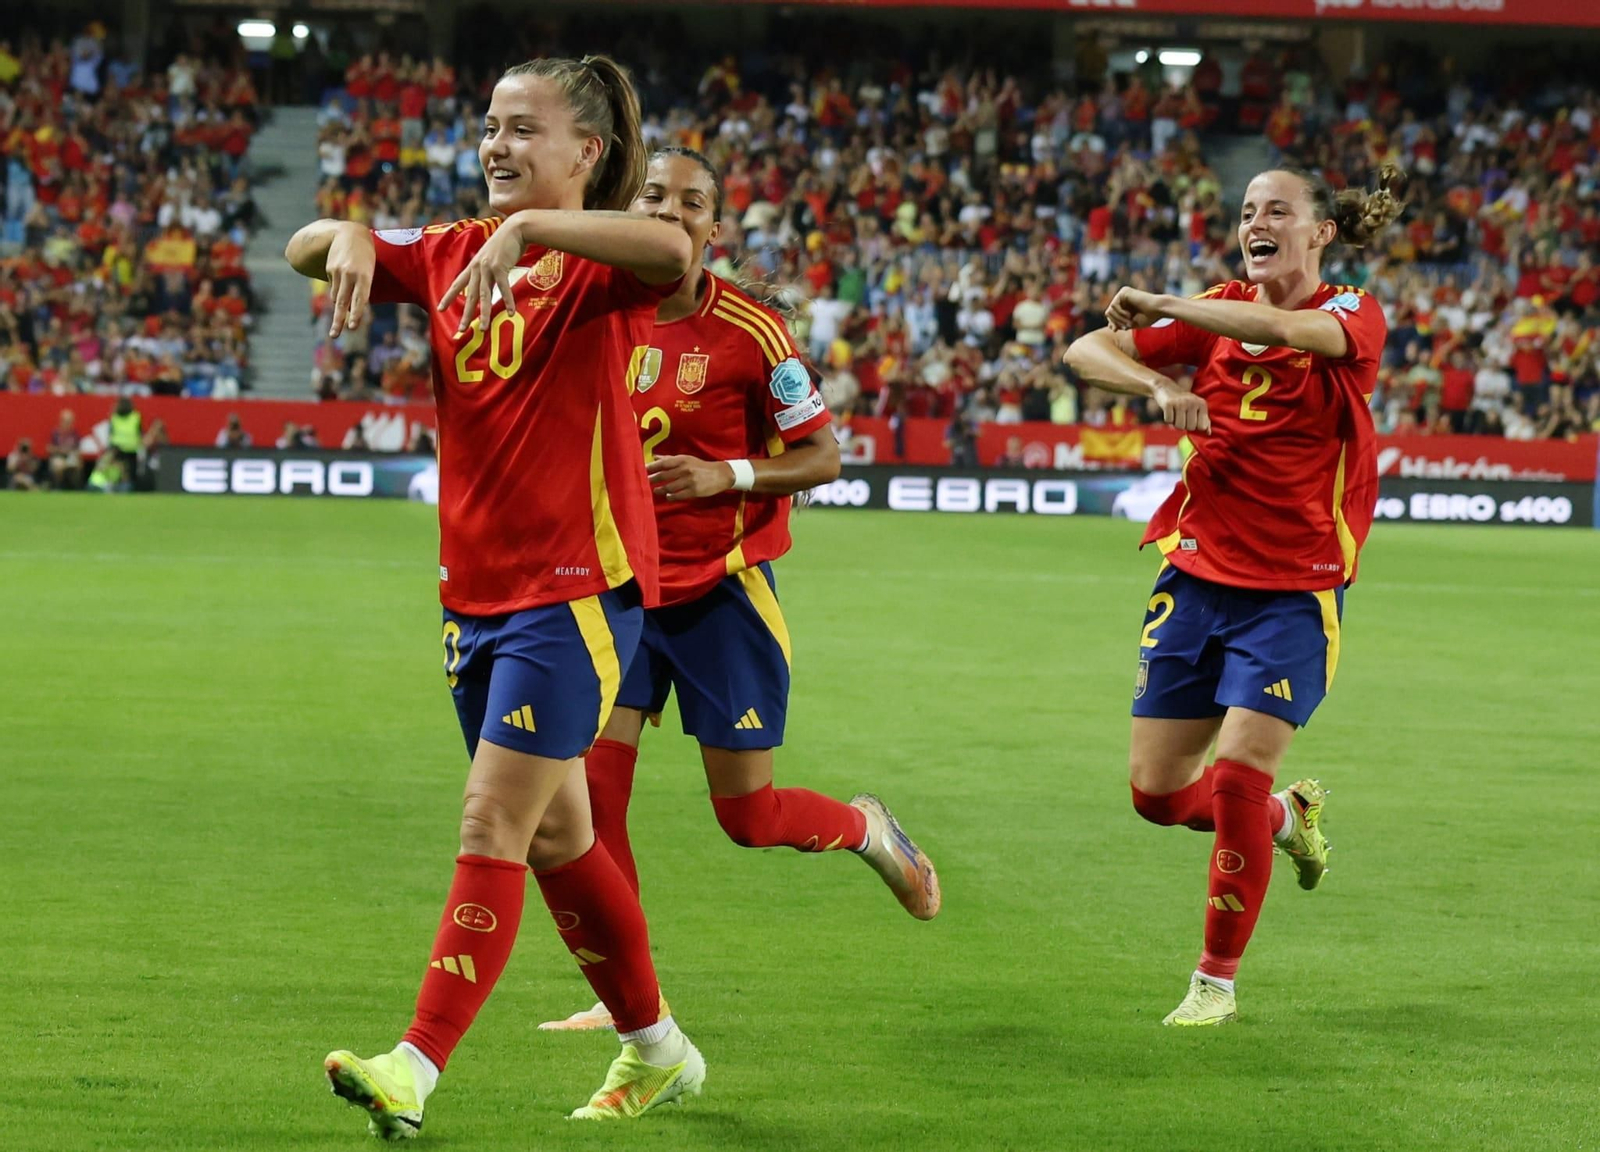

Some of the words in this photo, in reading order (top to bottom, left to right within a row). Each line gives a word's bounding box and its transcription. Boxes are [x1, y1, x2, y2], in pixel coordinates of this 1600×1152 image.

[452, 309, 526, 383] 20
[1239, 365, 1272, 421] 2
[1409, 492, 1497, 522] EBRO
[1499, 496, 1572, 524] s400
[555, 566, 590, 576] HEAT.RDY
[1140, 591, 1175, 648] 2
